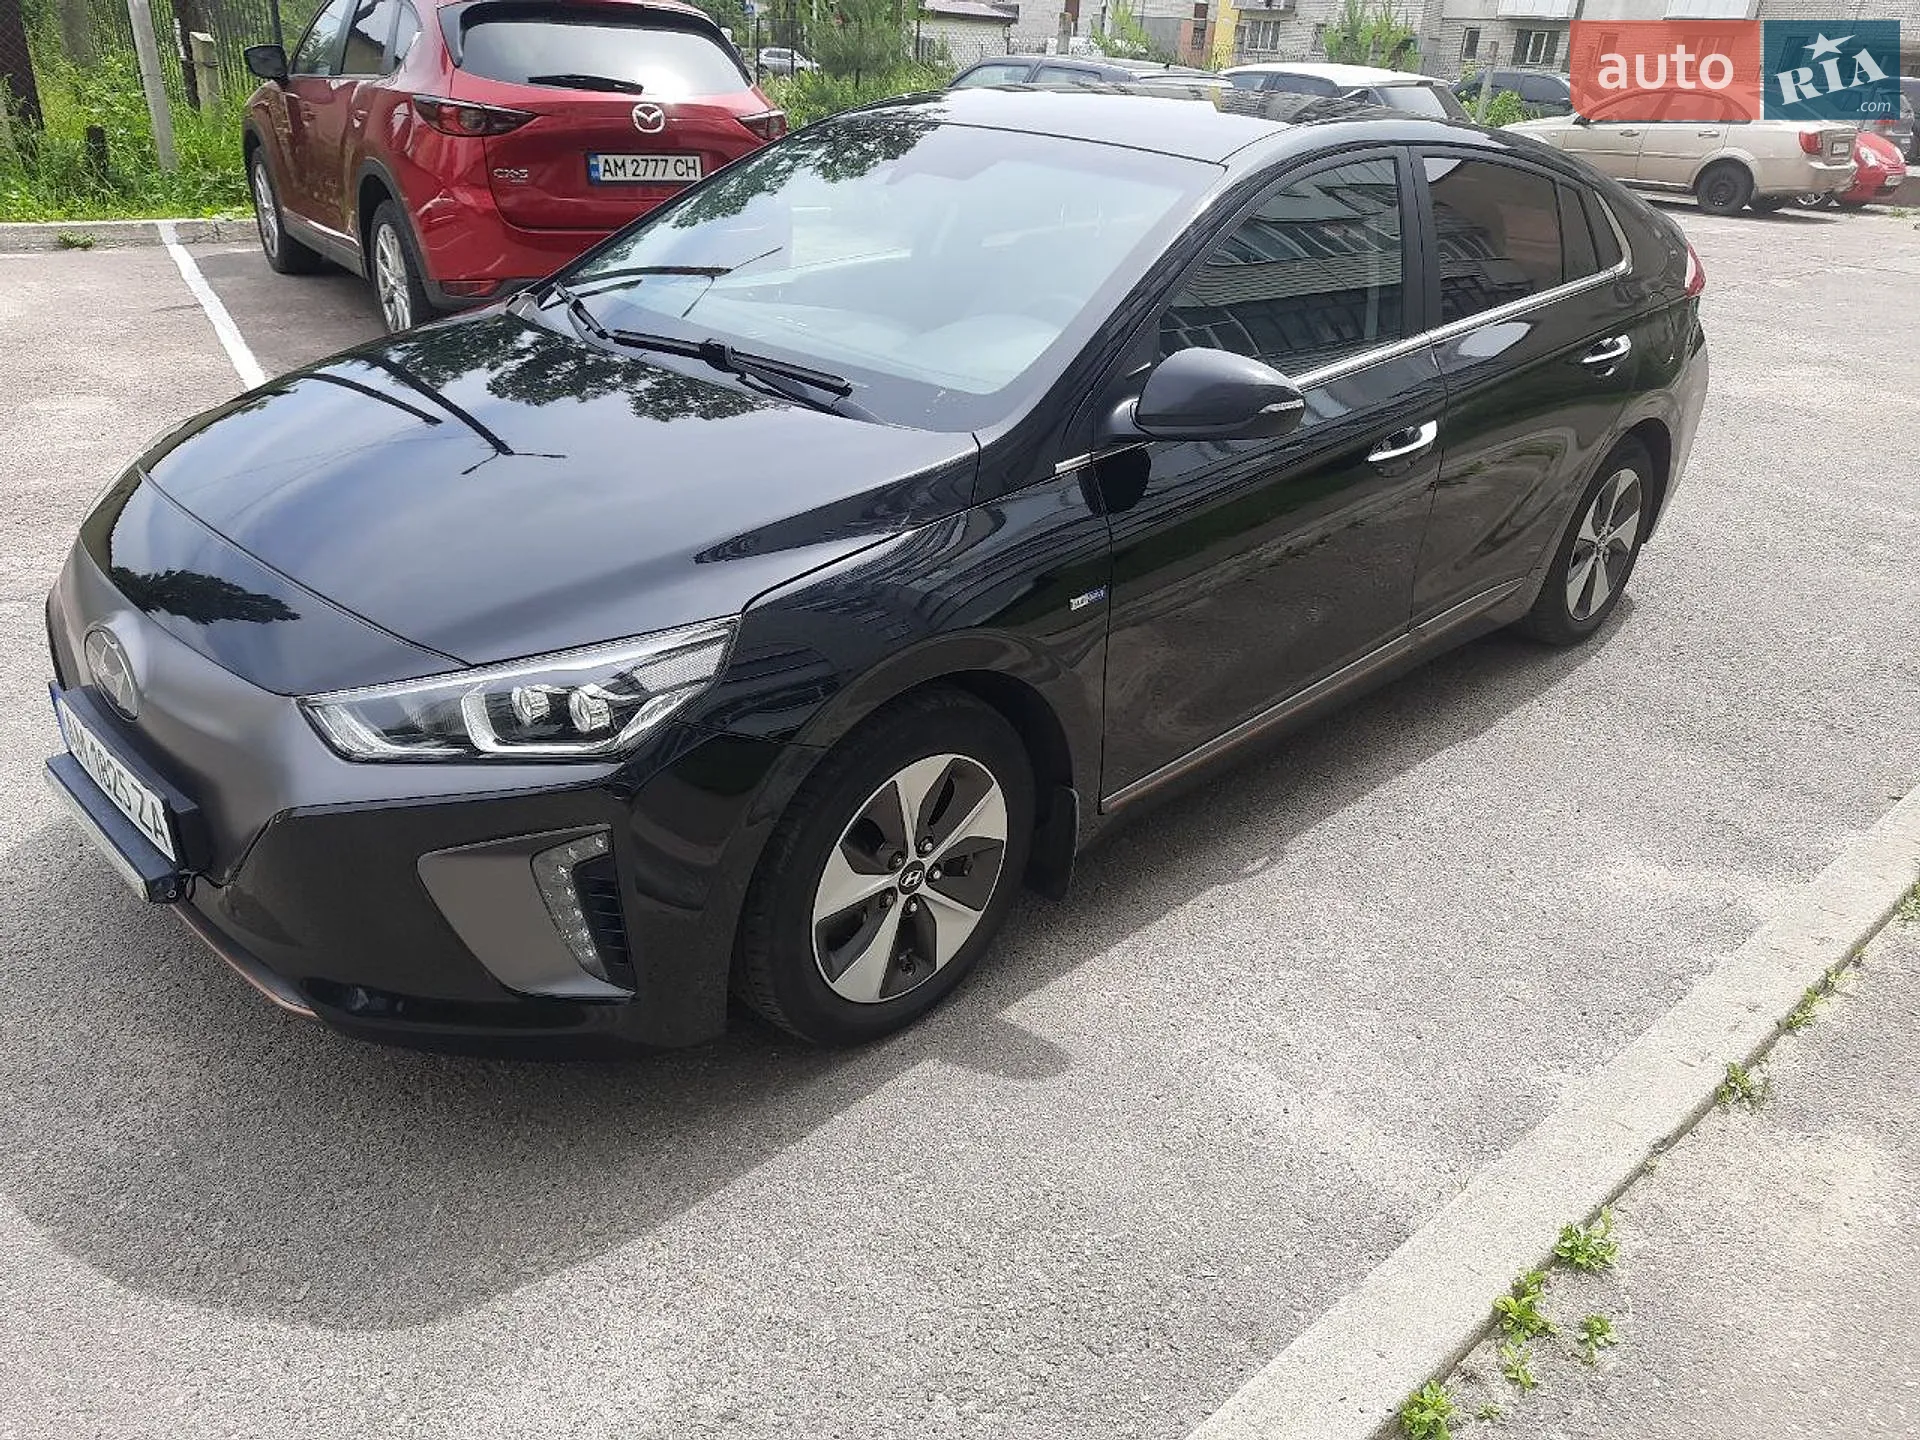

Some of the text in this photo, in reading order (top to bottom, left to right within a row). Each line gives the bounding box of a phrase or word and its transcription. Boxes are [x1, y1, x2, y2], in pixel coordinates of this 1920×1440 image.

[602, 158, 698, 177] AM 2777 CH
[131, 783, 170, 851] ZA
